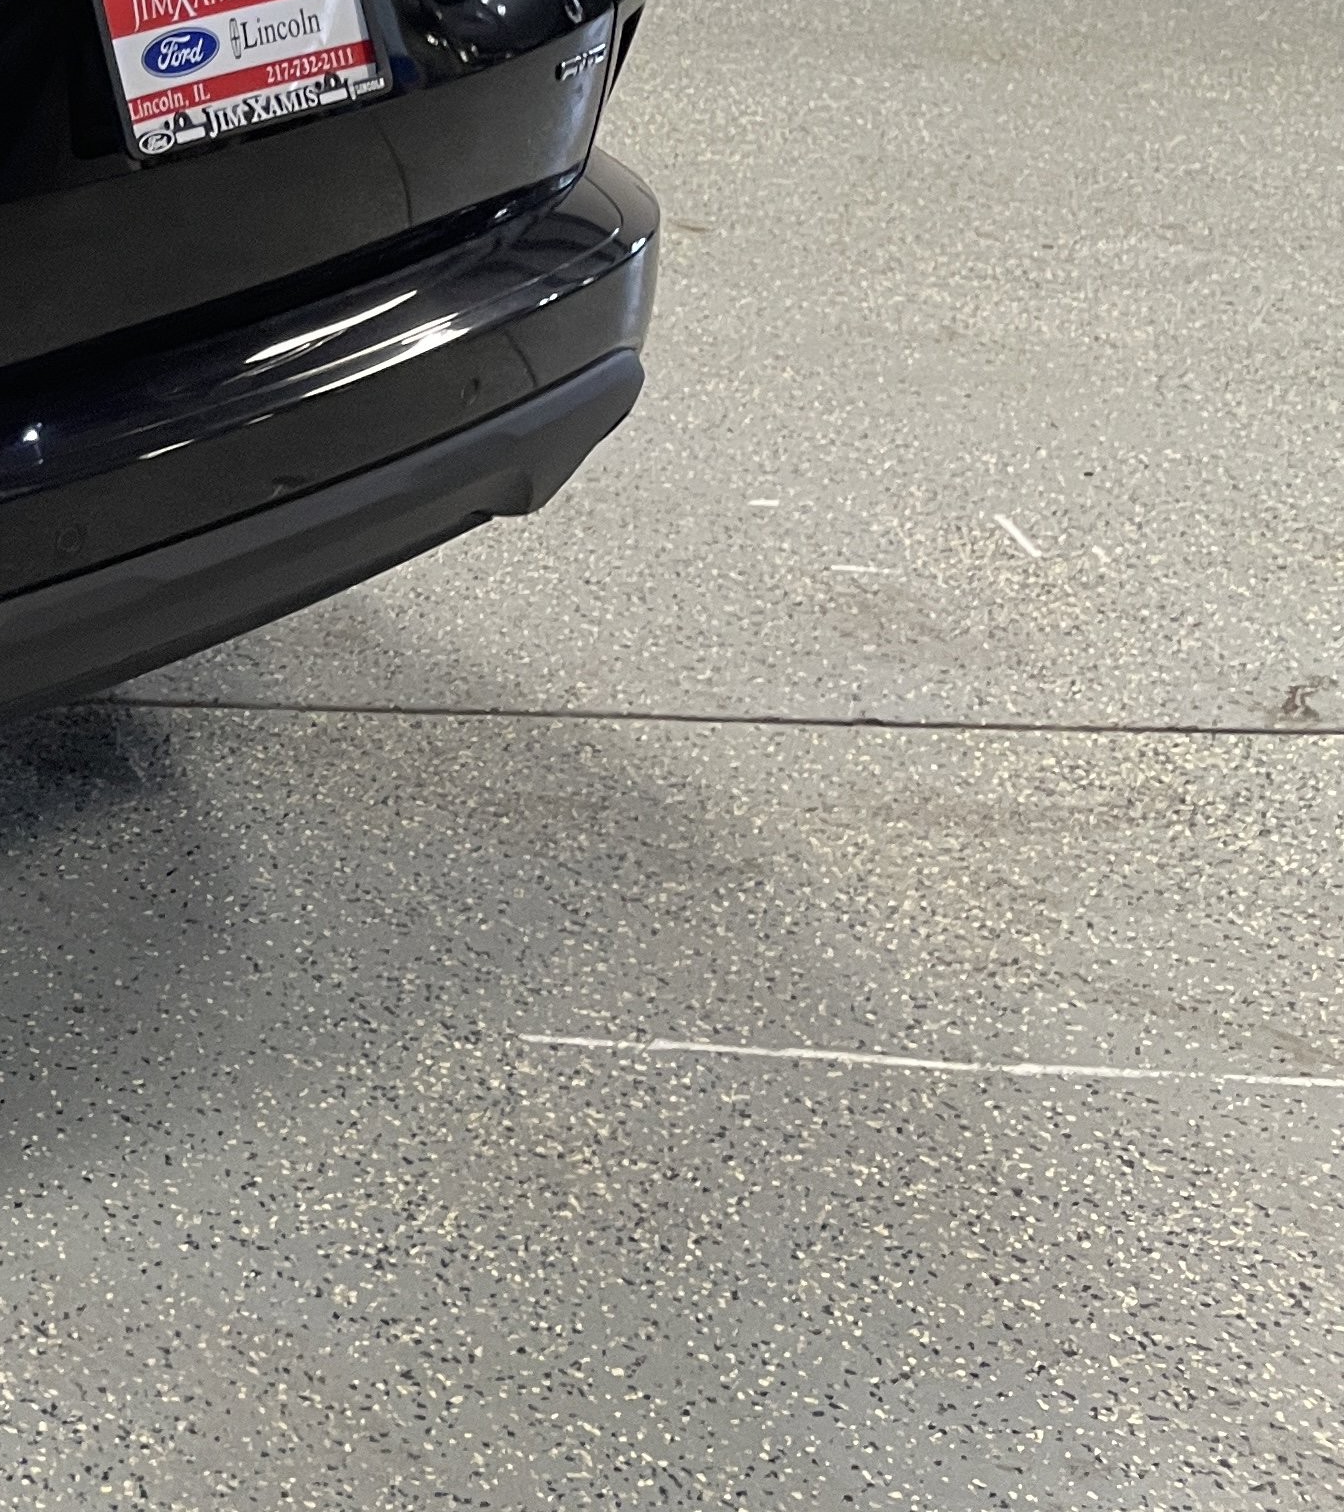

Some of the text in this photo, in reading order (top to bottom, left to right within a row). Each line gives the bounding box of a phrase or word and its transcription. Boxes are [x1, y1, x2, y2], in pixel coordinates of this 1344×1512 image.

[240, 7, 322, 51] Lincoln
[157, 32, 205, 70] Ford
[265, 47, 355, 83] 217-732-2111
[128, 83, 211, 121] Lincoln, IL
[207, 88, 320, 138] JIM XAMIS
